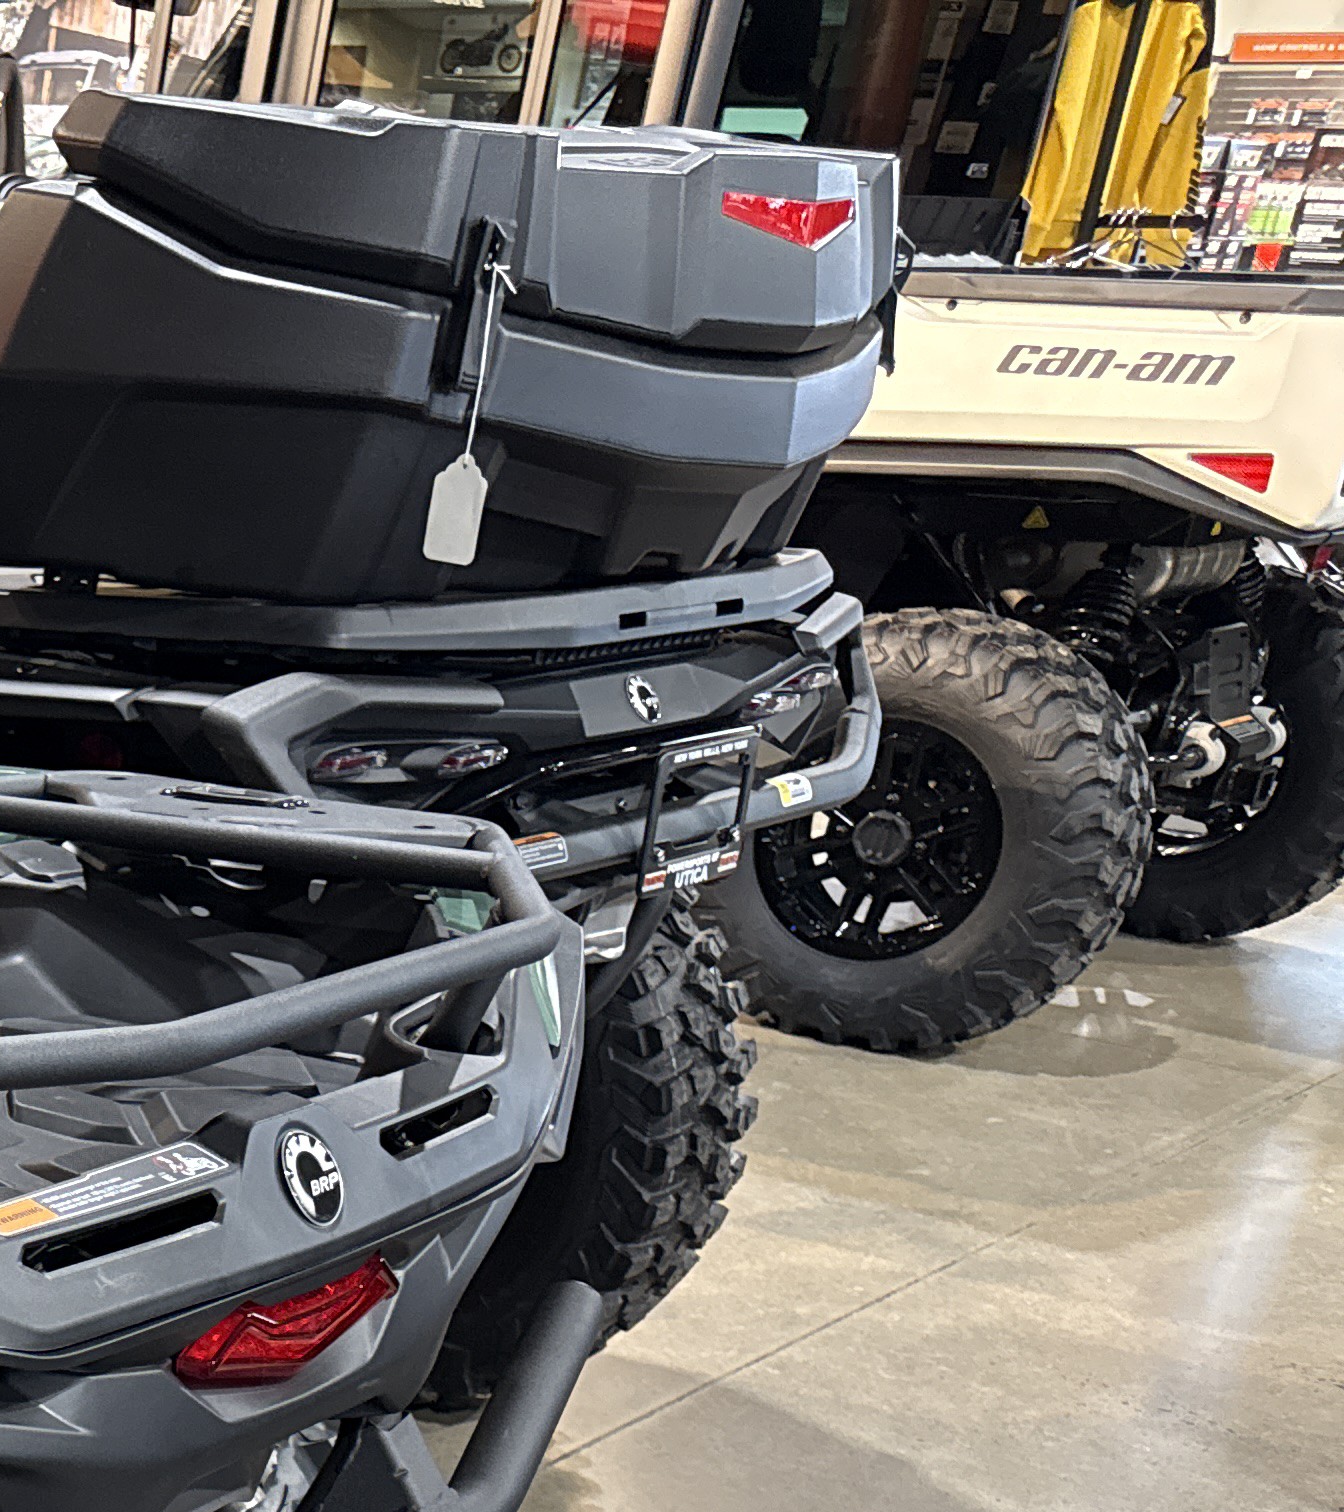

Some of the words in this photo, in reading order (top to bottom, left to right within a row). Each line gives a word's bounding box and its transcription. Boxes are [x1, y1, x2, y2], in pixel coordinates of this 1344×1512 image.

[996, 344, 1236, 386] can-am
[688, 750, 703, 761] YORK
[734, 739, 749, 751] YORK
[666, 853, 711, 874] POWERSPORTS
[674, 865, 709, 889] UTICA
[310, 1171, 340, 1197] BRP
[0, 1205, 44, 1226] WARNING
